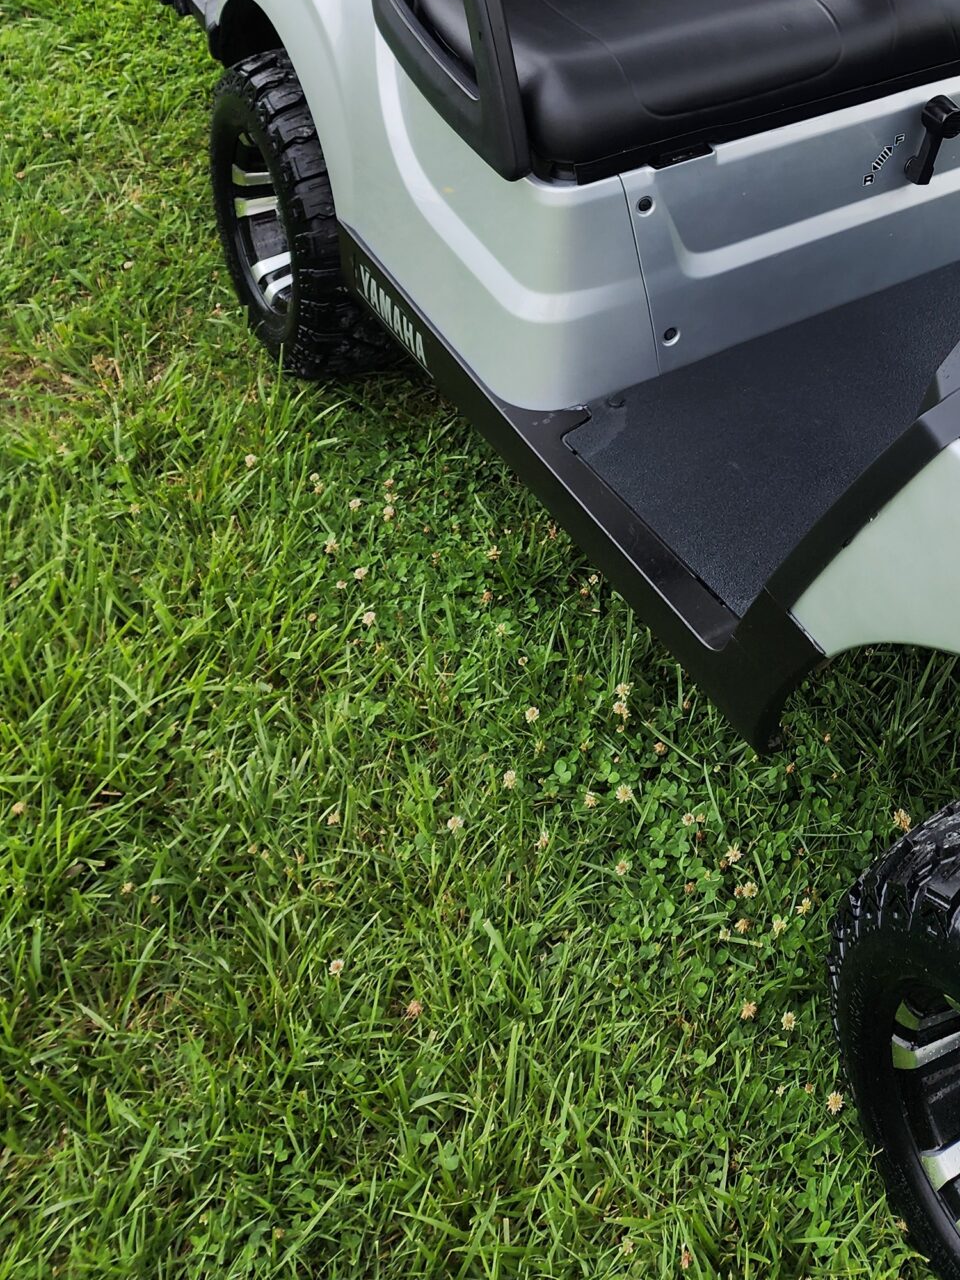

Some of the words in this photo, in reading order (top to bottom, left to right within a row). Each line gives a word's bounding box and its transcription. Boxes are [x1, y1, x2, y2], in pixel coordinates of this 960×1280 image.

[894, 133, 905, 146] F
[862, 173, 875, 187] R
[359, 263, 428, 368] YAMAHA
